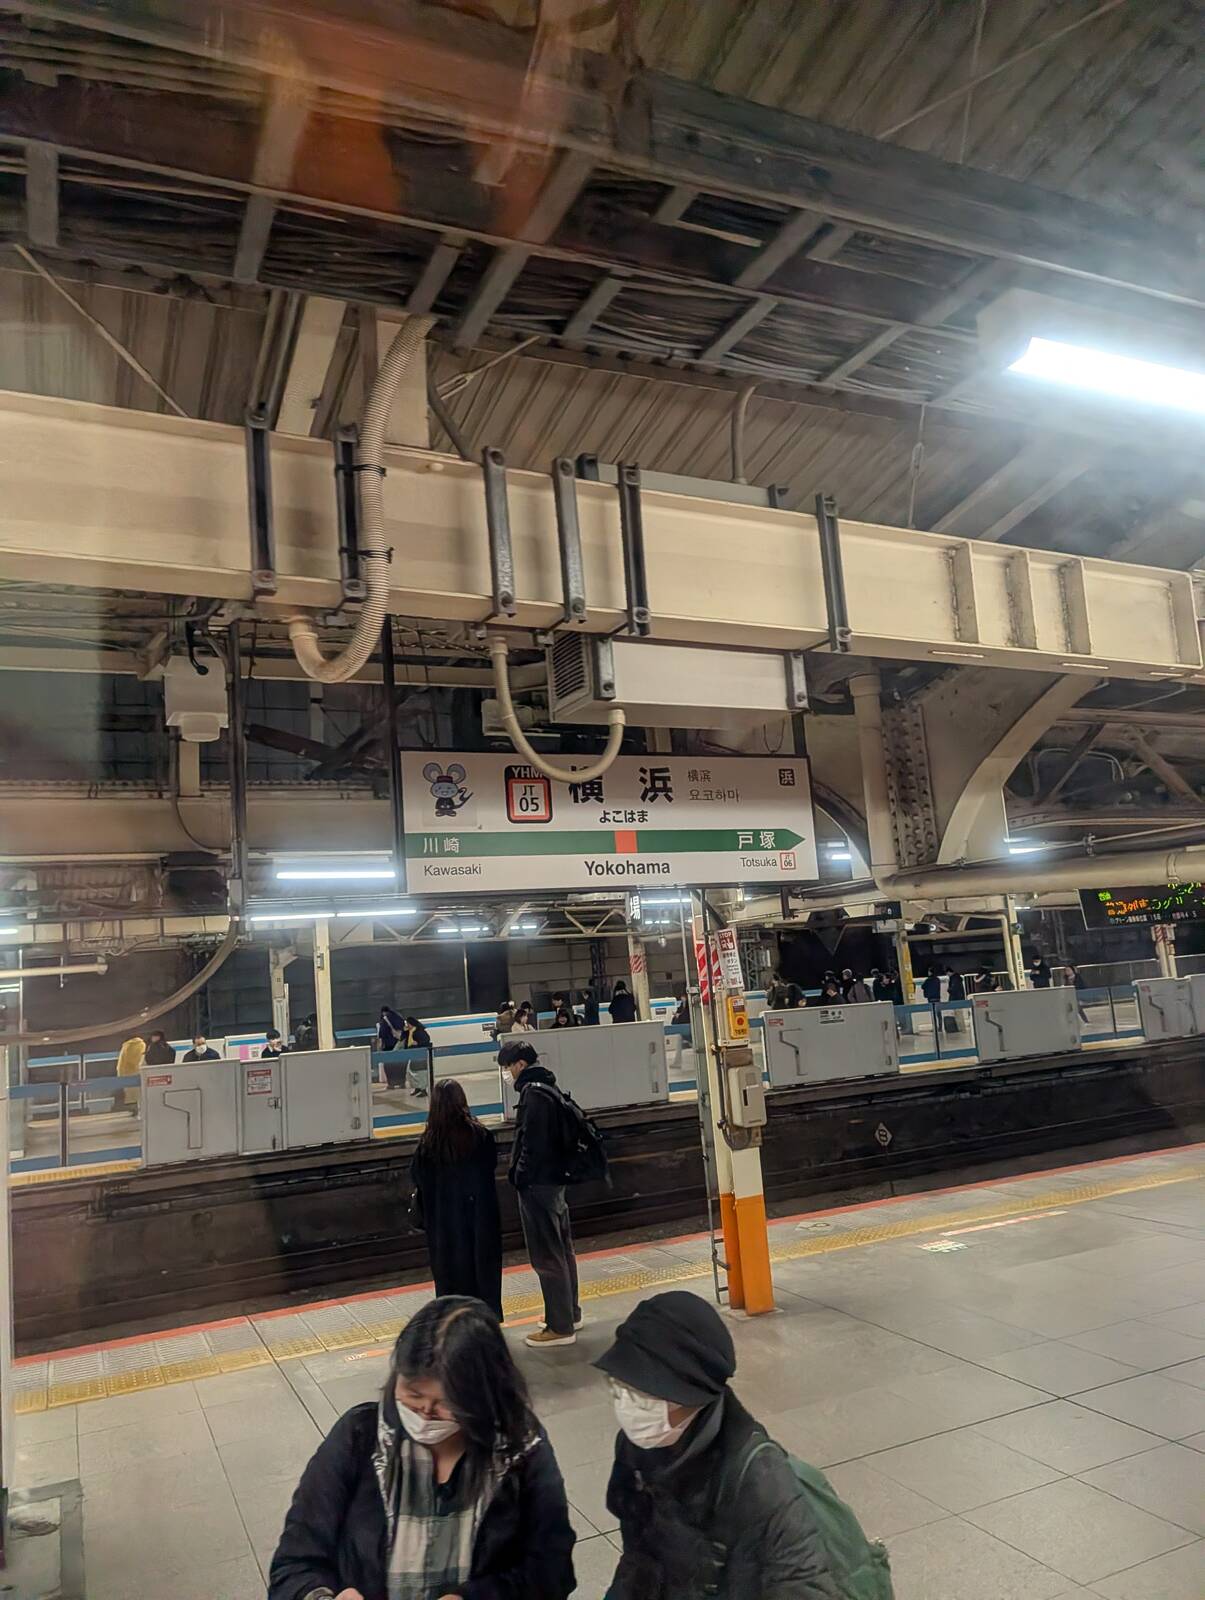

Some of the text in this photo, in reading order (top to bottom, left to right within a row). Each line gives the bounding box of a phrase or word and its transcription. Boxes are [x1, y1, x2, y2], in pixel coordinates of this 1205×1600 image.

[511, 767, 545, 778] YHM
[780, 769, 795, 785] 浜
[522, 785, 535, 796] JT
[689, 788, 739, 803] 요코하마
[519, 797, 540, 812] 05
[599, 810, 648, 823] よこはま
[423, 837, 460, 854] 川崎
[736, 831, 776, 850] 戸塚
[424, 863, 482, 876] Kawasaki
[584, 860, 670, 876] Yokohama
[740, 857, 777, 868] Totsuka
[783, 859, 793, 867] 06
